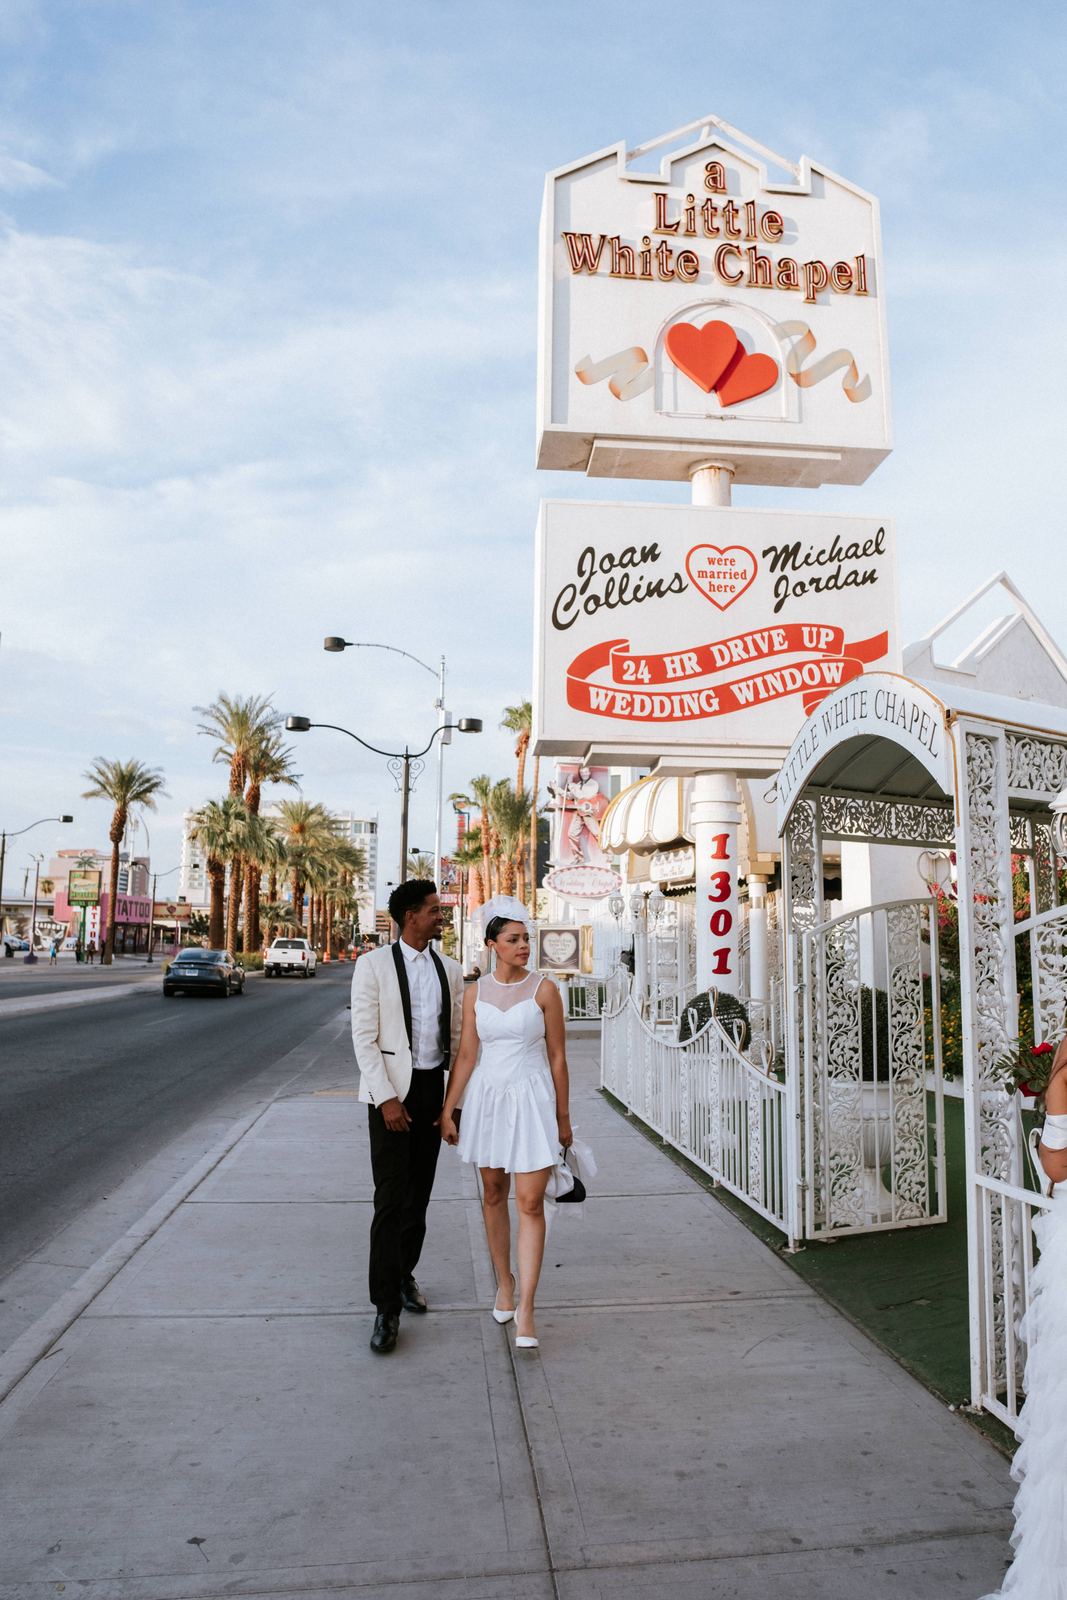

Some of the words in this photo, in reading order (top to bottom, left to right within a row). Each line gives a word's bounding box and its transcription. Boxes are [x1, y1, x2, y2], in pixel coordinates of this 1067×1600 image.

[704, 161, 727, 193] a
[652, 192, 784, 243] Little
[562, 231, 700, 282] White
[713, 242, 869, 304] Chapel
[577, 542, 661, 595] Joan
[697, 568, 747, 581] married
[707, 556, 737, 567] were
[762, 527, 886, 573] Michael
[552, 572, 688, 630] Collins
[708, 581, 736, 593] here
[773, 565, 879, 614] Jordan
[622, 659, 651, 683] 24
[664, 654, 702, 679] HR
[710, 628, 788, 667] DRIVE
[801, 626, 835, 649] UP
[588, 686, 720, 718] WEDDING
[730, 662, 844, 705] WINDOW
[780, 724, 820, 806] LITTLE
[821, 690, 868, 736] WHITE
[874, 688, 939, 760] CHAPEL
[117, 898, 150, 918] TATTOO
[707, 833, 733, 975] 1301
